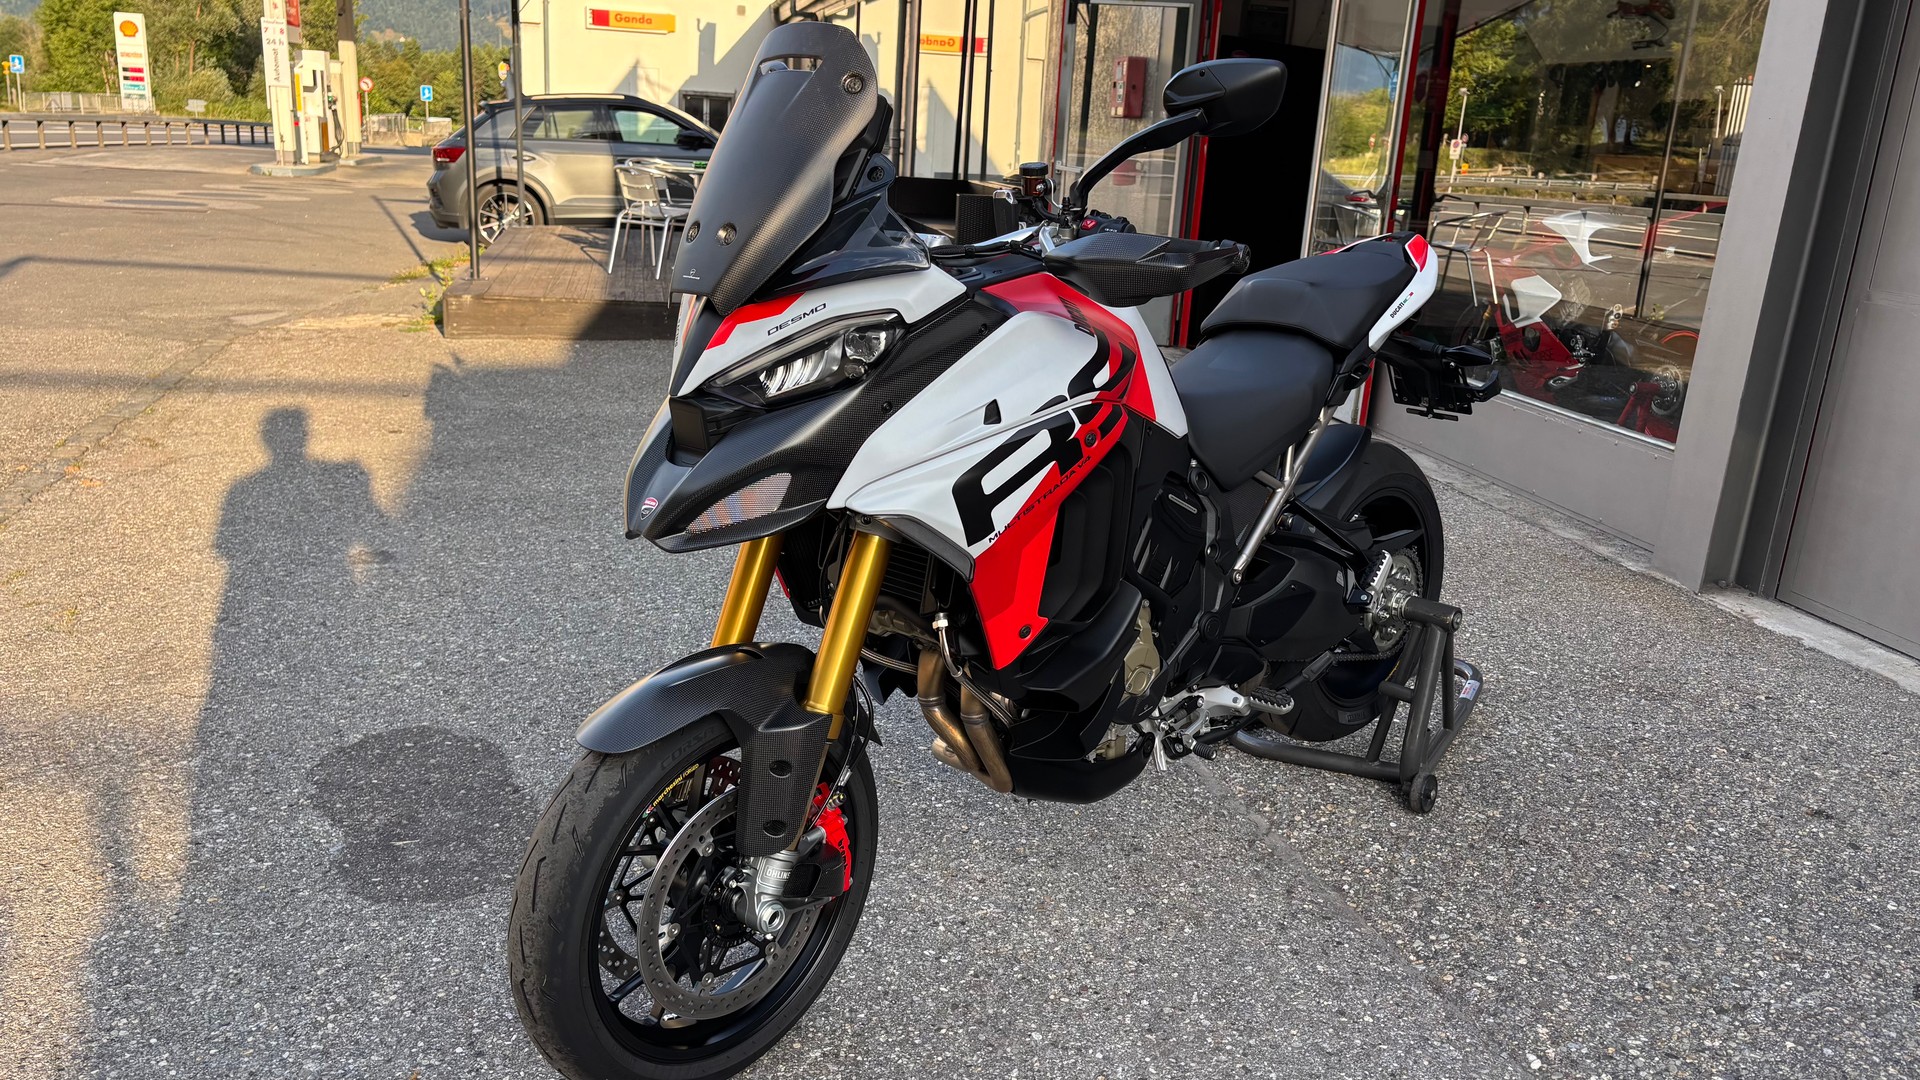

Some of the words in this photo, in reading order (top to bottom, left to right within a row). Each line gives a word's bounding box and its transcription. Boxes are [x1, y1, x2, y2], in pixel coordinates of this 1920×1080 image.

[614, 13, 653, 25] Ganda
[767, 302, 827, 337] DESMO
[1389, 301, 1405, 319] DUCATI
[988, 470, 1076, 544] MULTISTRADA
[1078, 455, 1092, 468] V4
[653, 774, 683, 807] marchesini
[837, 838, 849, 873] bremb
